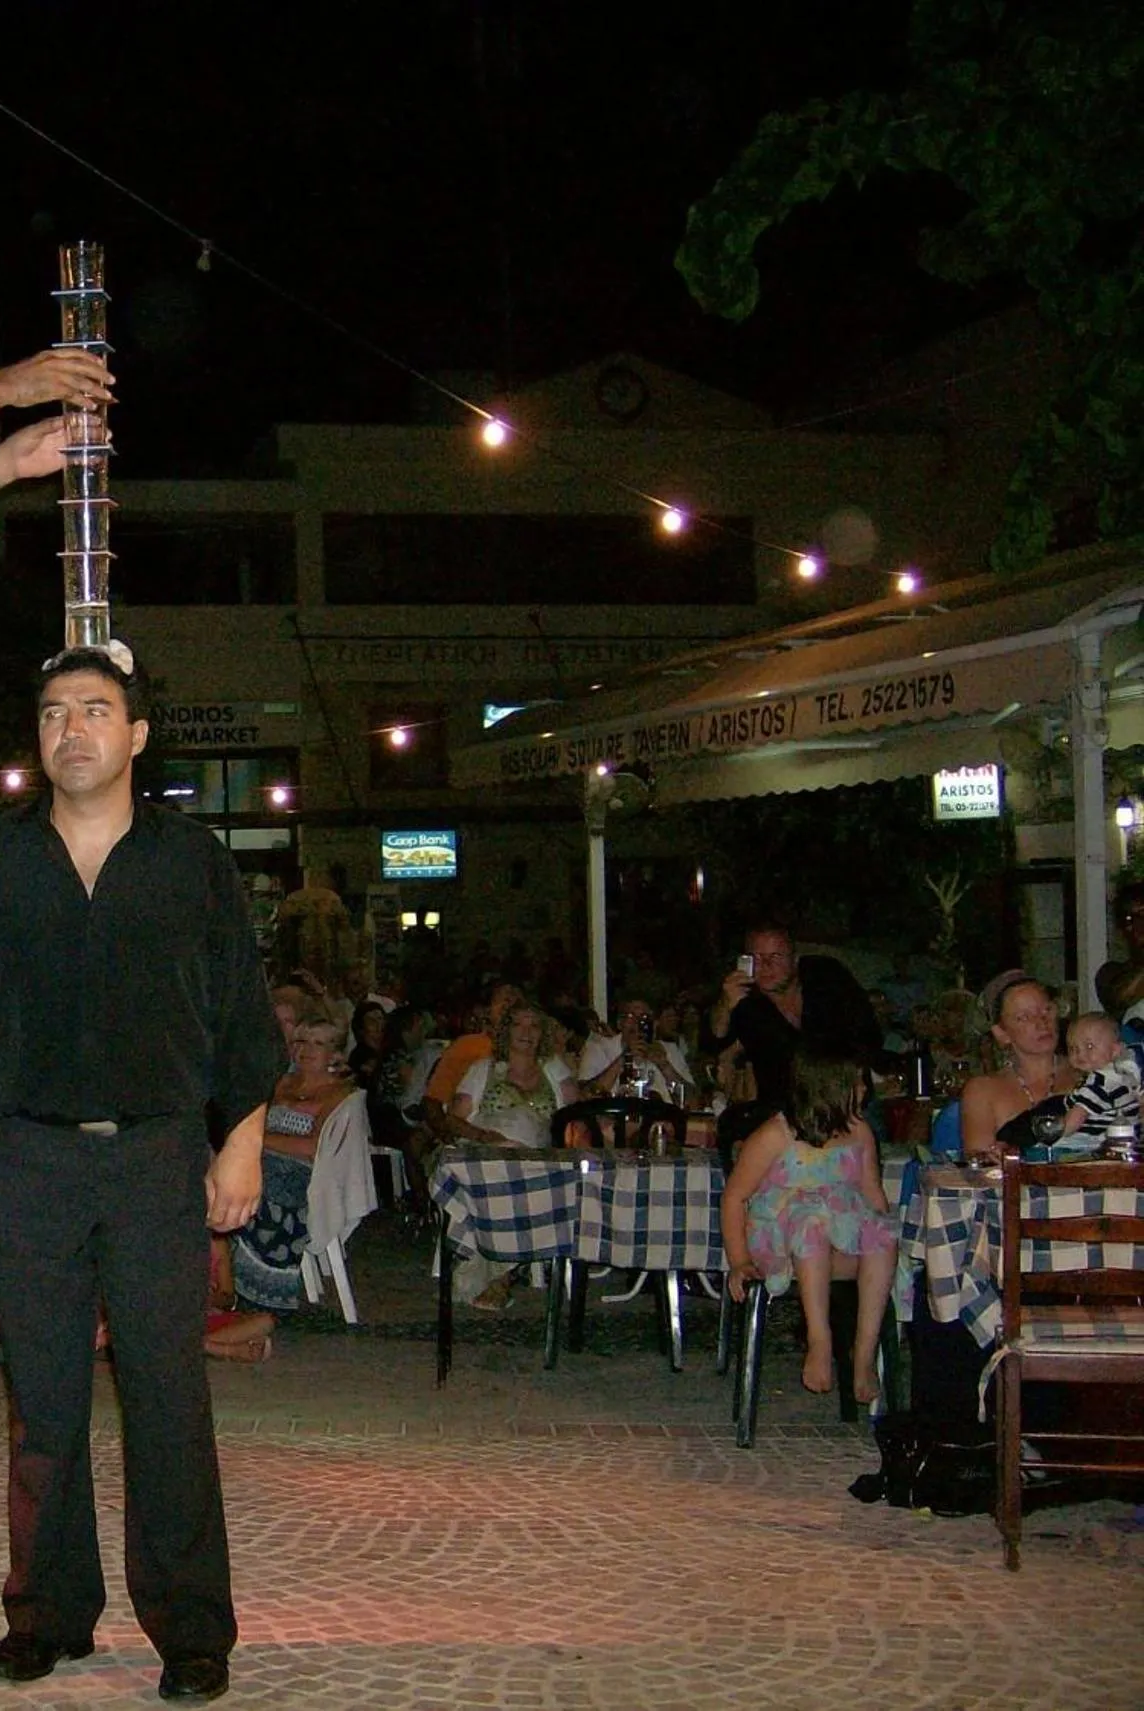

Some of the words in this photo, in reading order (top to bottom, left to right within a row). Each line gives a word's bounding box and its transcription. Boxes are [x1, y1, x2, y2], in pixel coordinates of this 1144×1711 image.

[567, 733, 625, 768] SQUARE
[632, 719, 690, 755] TAVERN
[815, 693, 854, 724] TEL.
[940, 784, 994, 798] ARISTOS
[387, 835, 418, 847] Coop
[418, 833, 449, 846] Bank
[388, 850, 449, 866] 24hr
